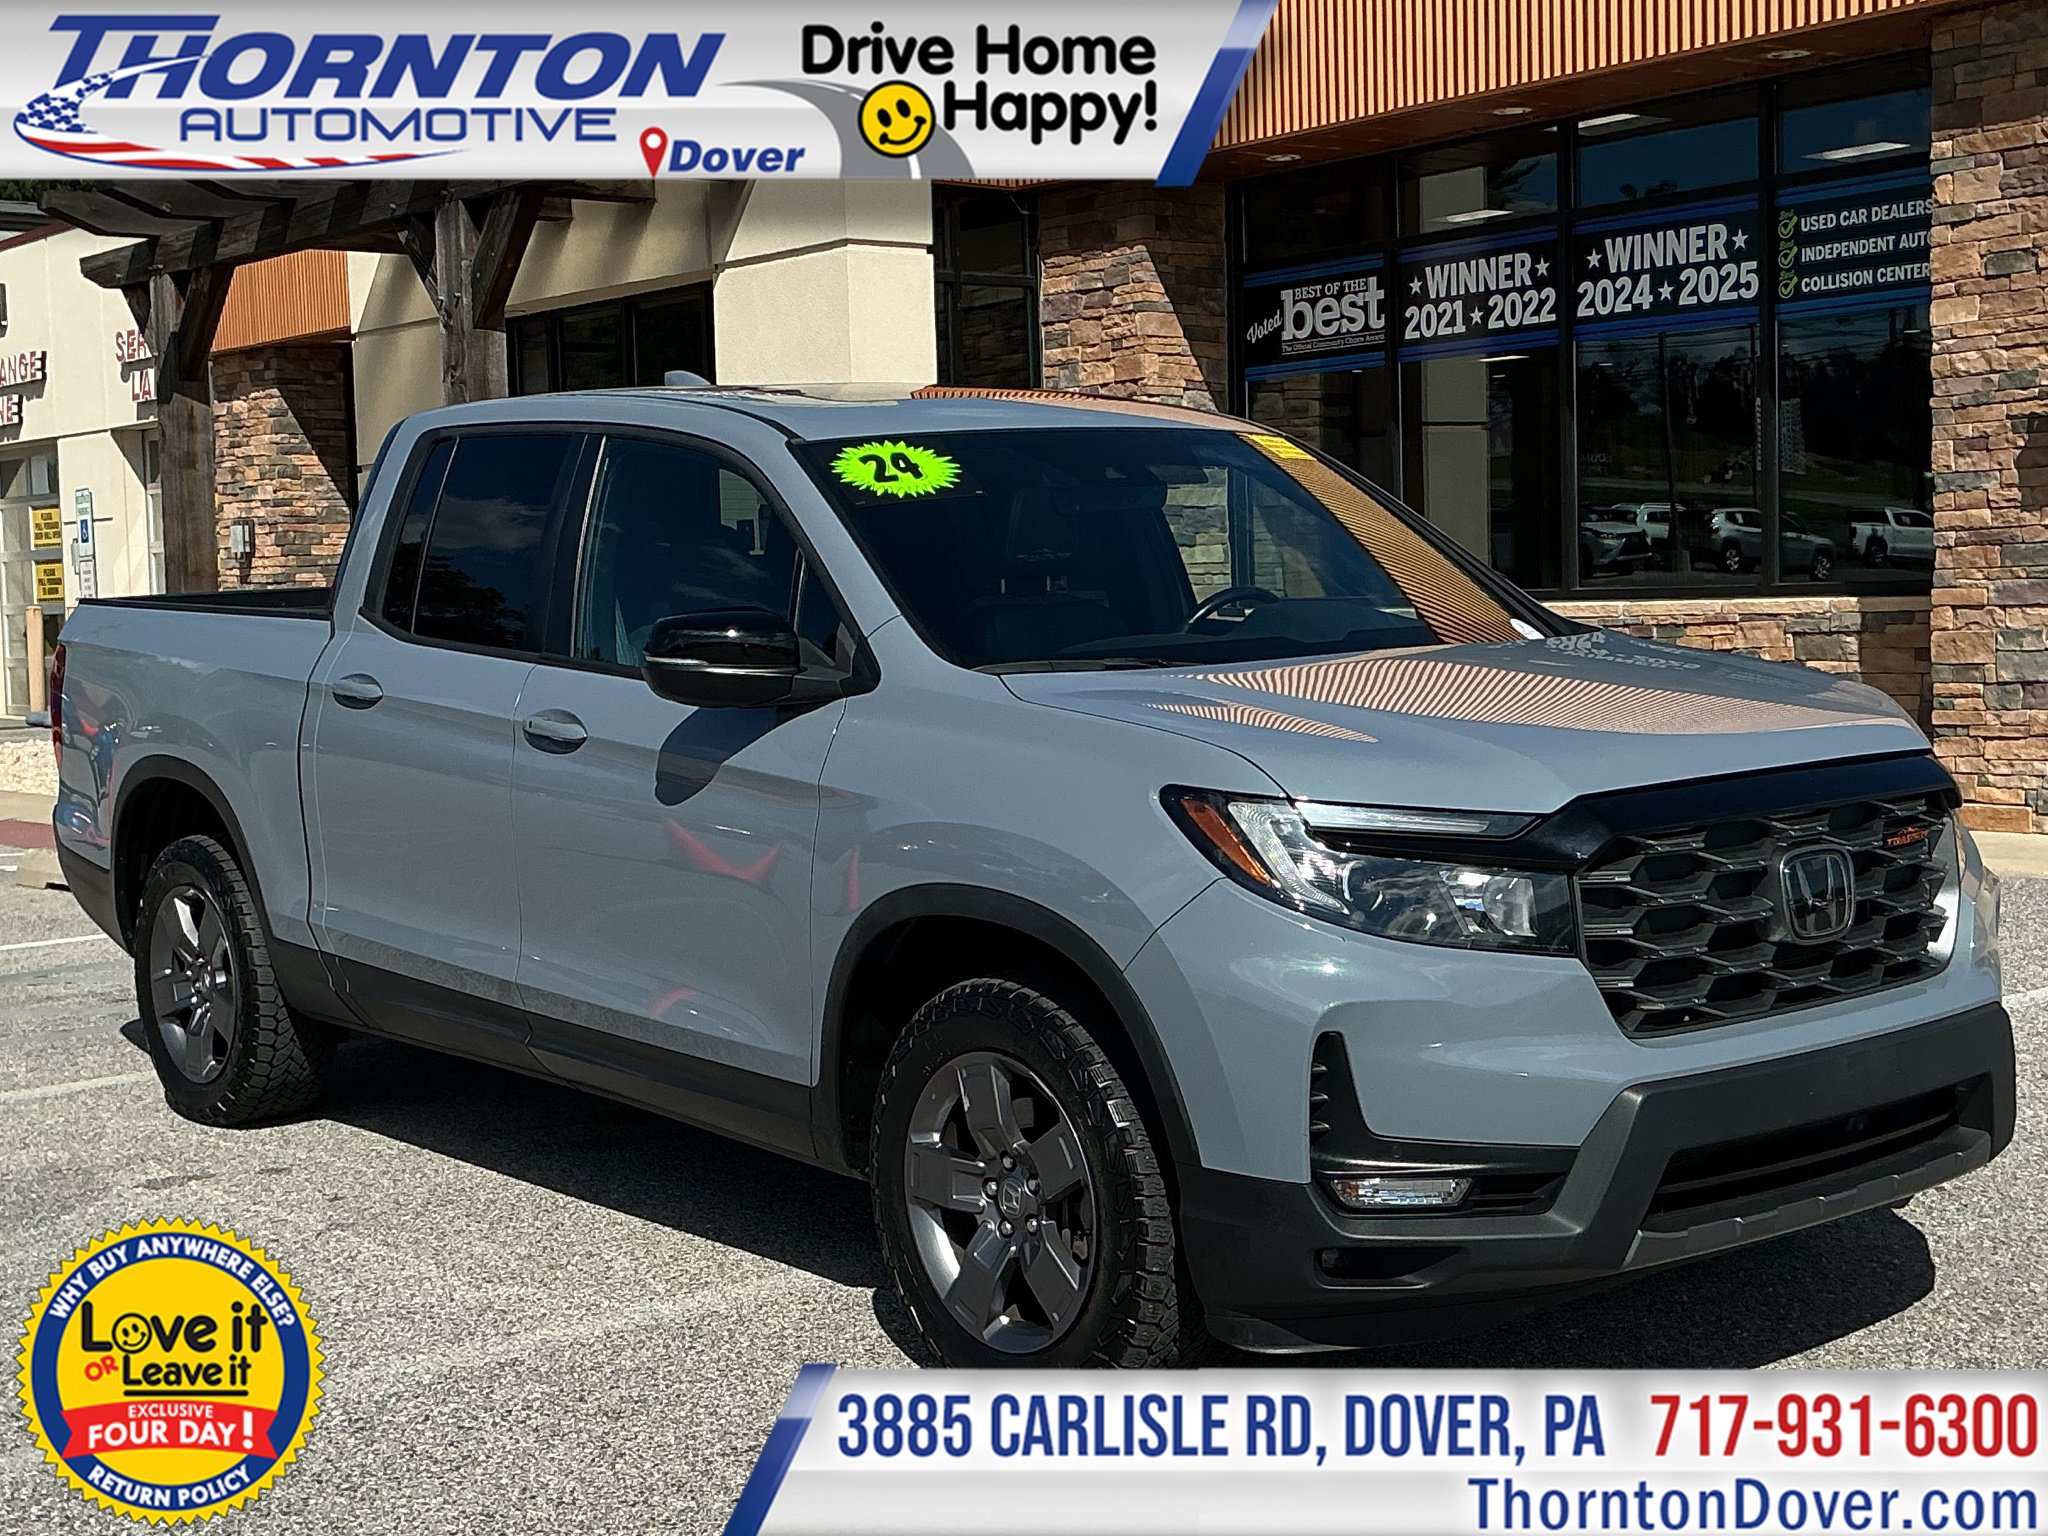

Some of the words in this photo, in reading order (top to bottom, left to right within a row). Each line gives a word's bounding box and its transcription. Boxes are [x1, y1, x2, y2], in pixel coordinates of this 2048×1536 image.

[1801, 213, 1837, 232] USED
[1839, 208, 1868, 227] CAR
[1871, 199, 1933, 222] DEALERS
[1604, 223, 1729, 274] WINNER
[1801, 235, 1896, 263] INDEPENDENT
[1294, 285, 1323, 300] BEST
[1324, 282, 1341, 296] OF
[1343, 278, 1367, 293] THE
[1425, 252, 1533, 299] WINNER
[1576, 274, 1653, 318] 2024
[1678, 261, 1760, 306] 2025
[1801, 269, 1873, 293] COLLISION
[1876, 262, 1931, 284] CENTER
[1281, 276, 1386, 341] best
[1404, 300, 1466, 341] 2021
[1487, 287, 1557, 330] 2022
[1246, 309, 1282, 344] Voted
[858, 452, 924, 483] 24
